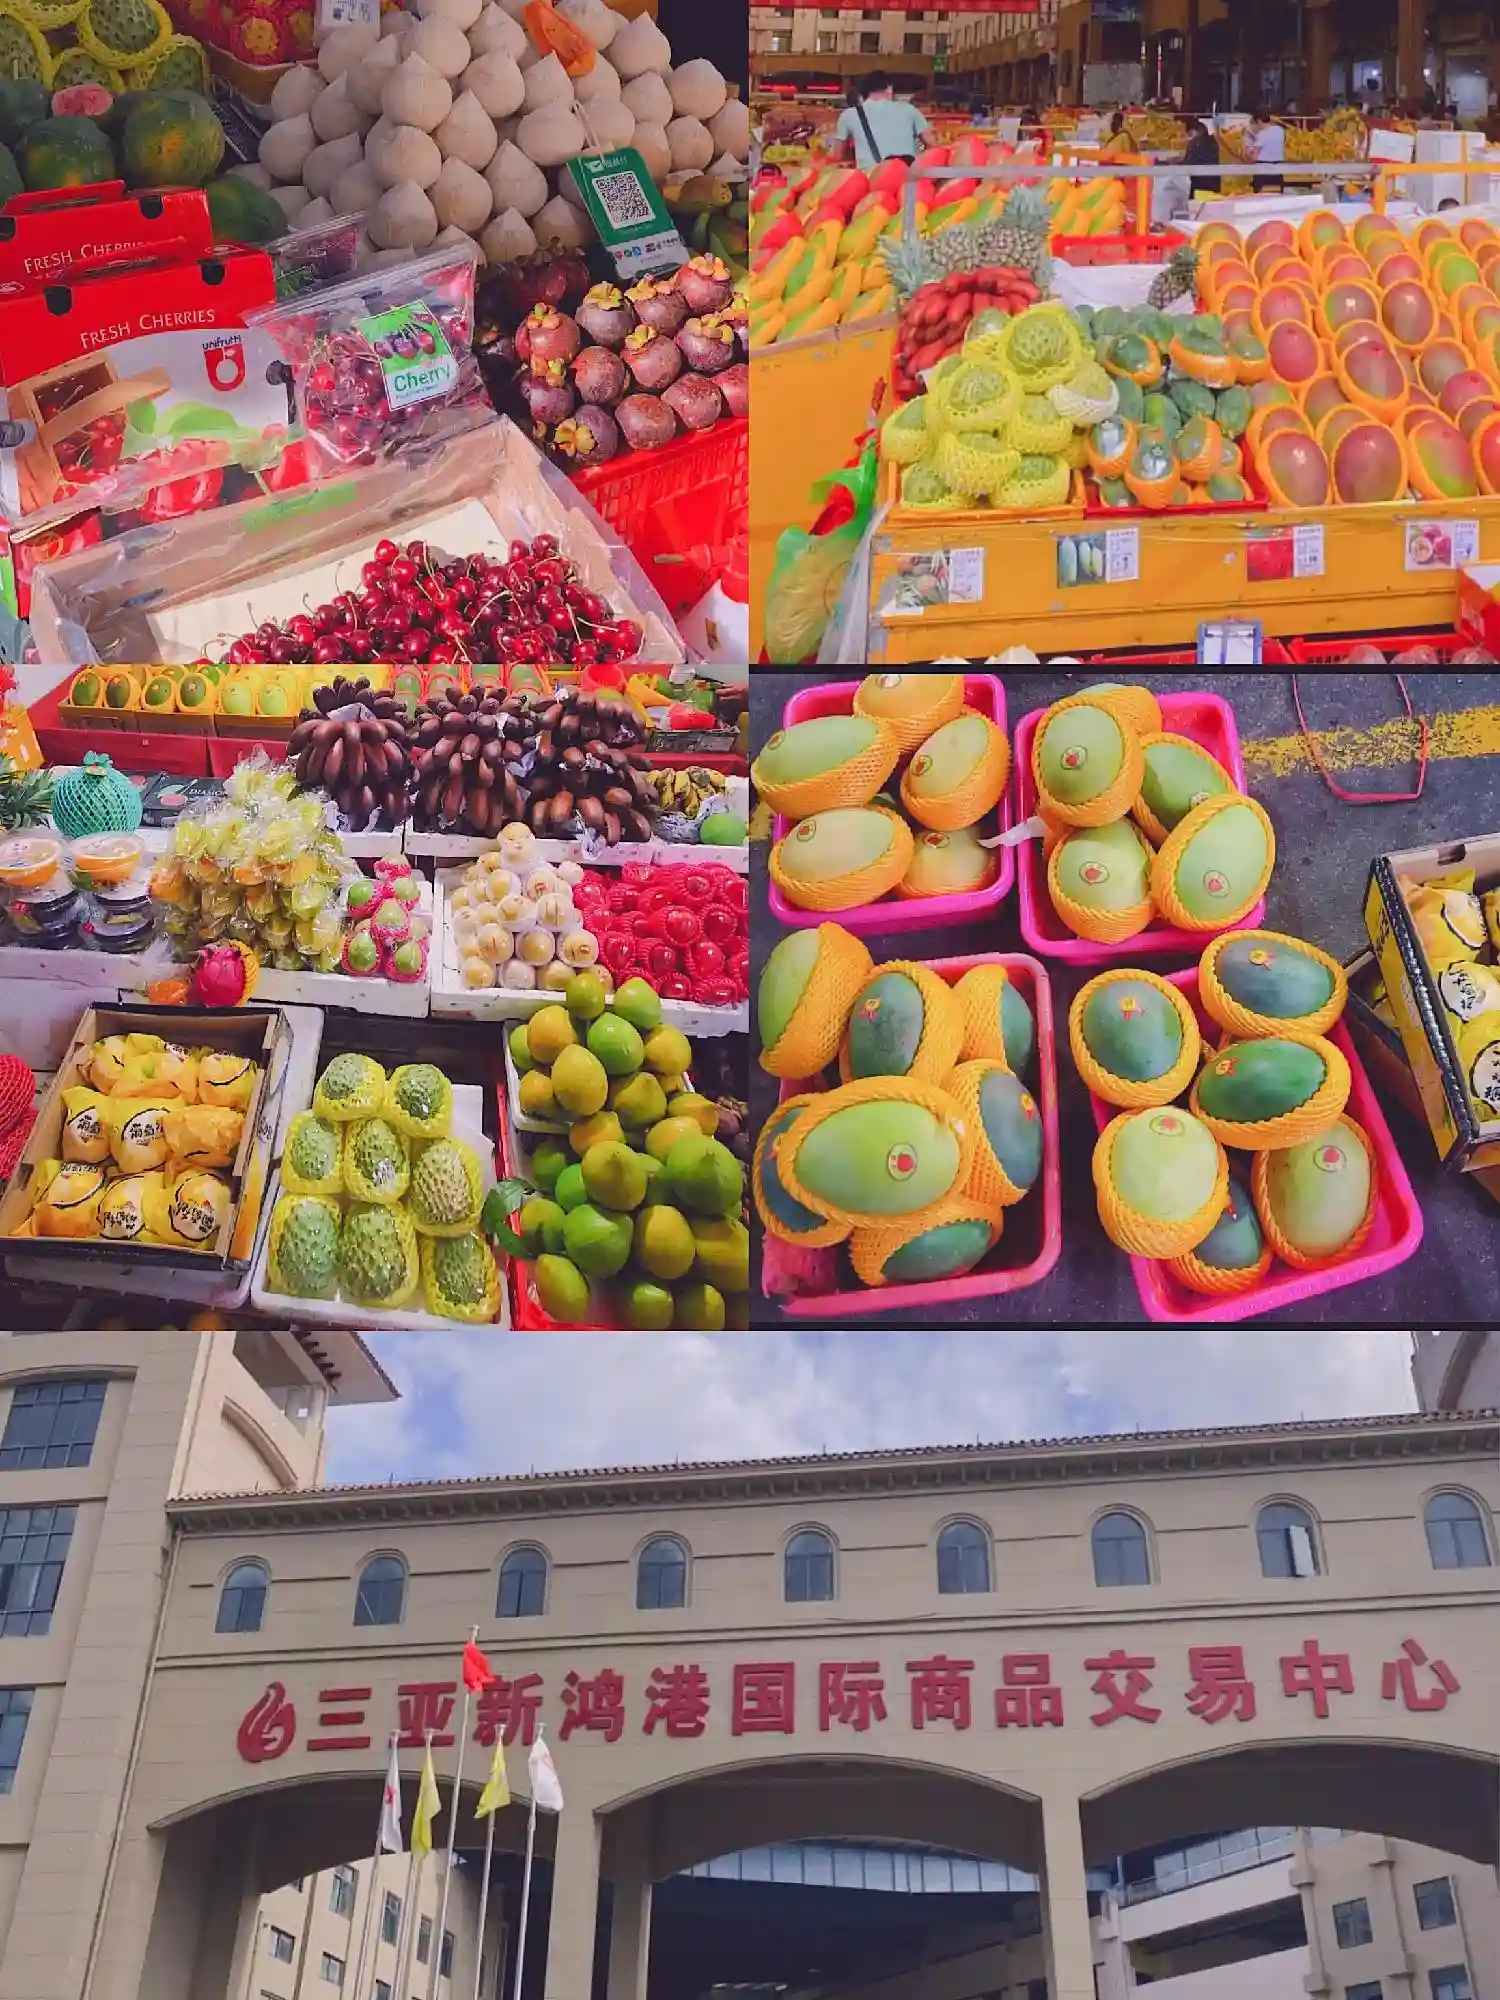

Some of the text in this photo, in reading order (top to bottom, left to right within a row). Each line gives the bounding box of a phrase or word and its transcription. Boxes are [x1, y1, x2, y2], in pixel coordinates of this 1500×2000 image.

[24, 249, 73, 274] FRESH
[80, 308, 216, 349] FRESH CHERRIES
[394, 363, 451, 392] Cherry
[306, 1637, 1461, 1751] 三亚新鸿港国际商品交易中心
